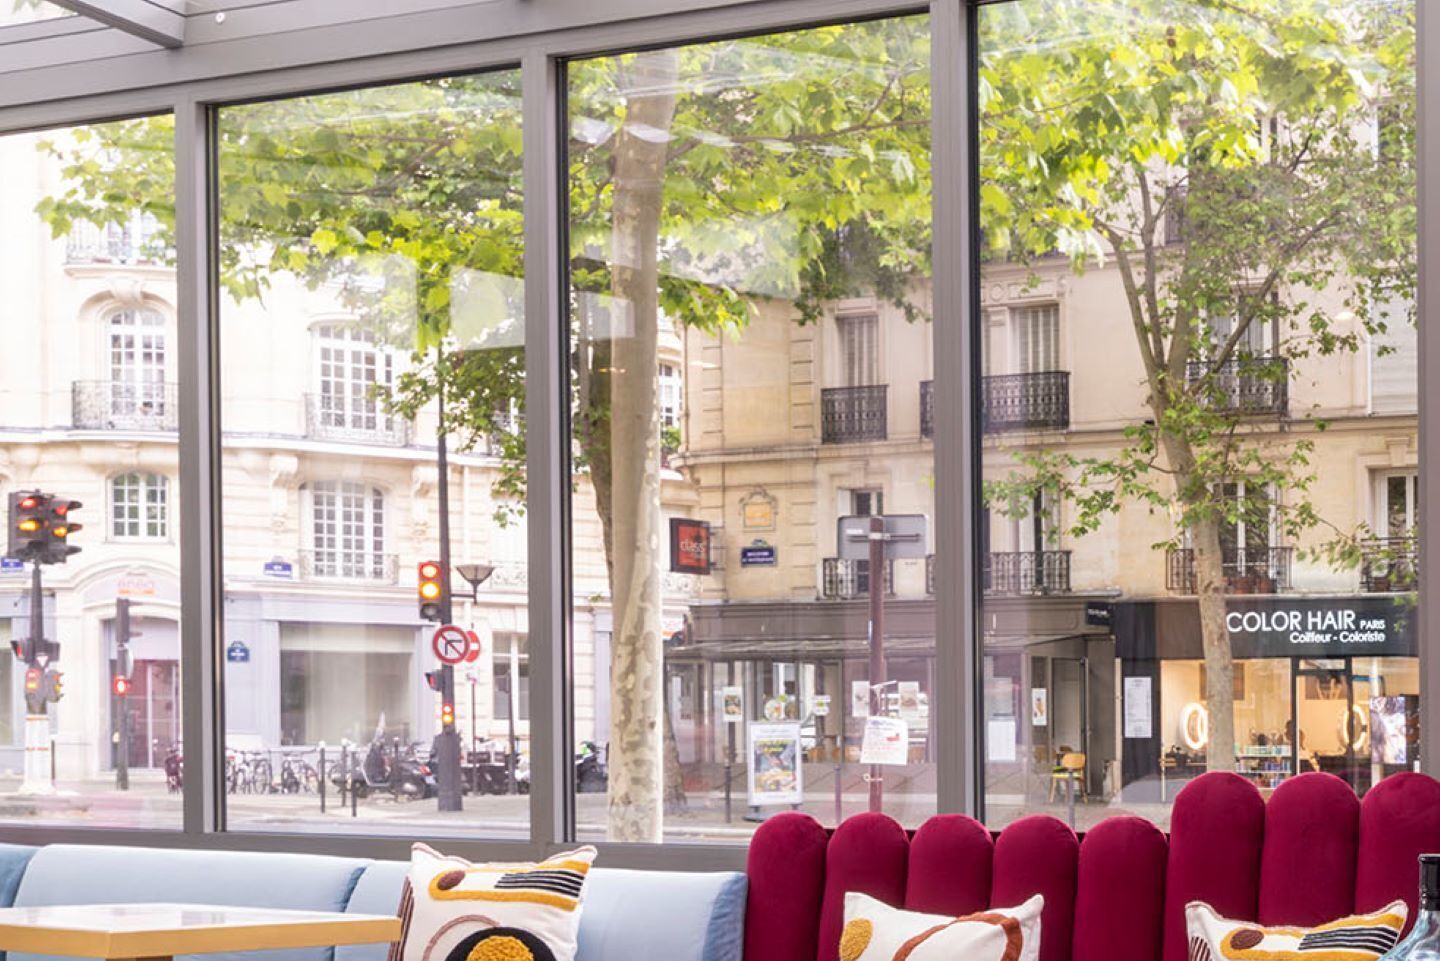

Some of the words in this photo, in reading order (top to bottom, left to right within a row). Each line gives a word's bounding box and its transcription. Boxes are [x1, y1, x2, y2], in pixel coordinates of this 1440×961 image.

[1226, 612, 1301, 632] COLOR
[1307, 610, 1356, 630] HAIR
[1360, 621, 1385, 630] PARIS
[1290, 632, 1331, 644] Coiffeur
[1340, 631, 1385, 643] Coloriste
